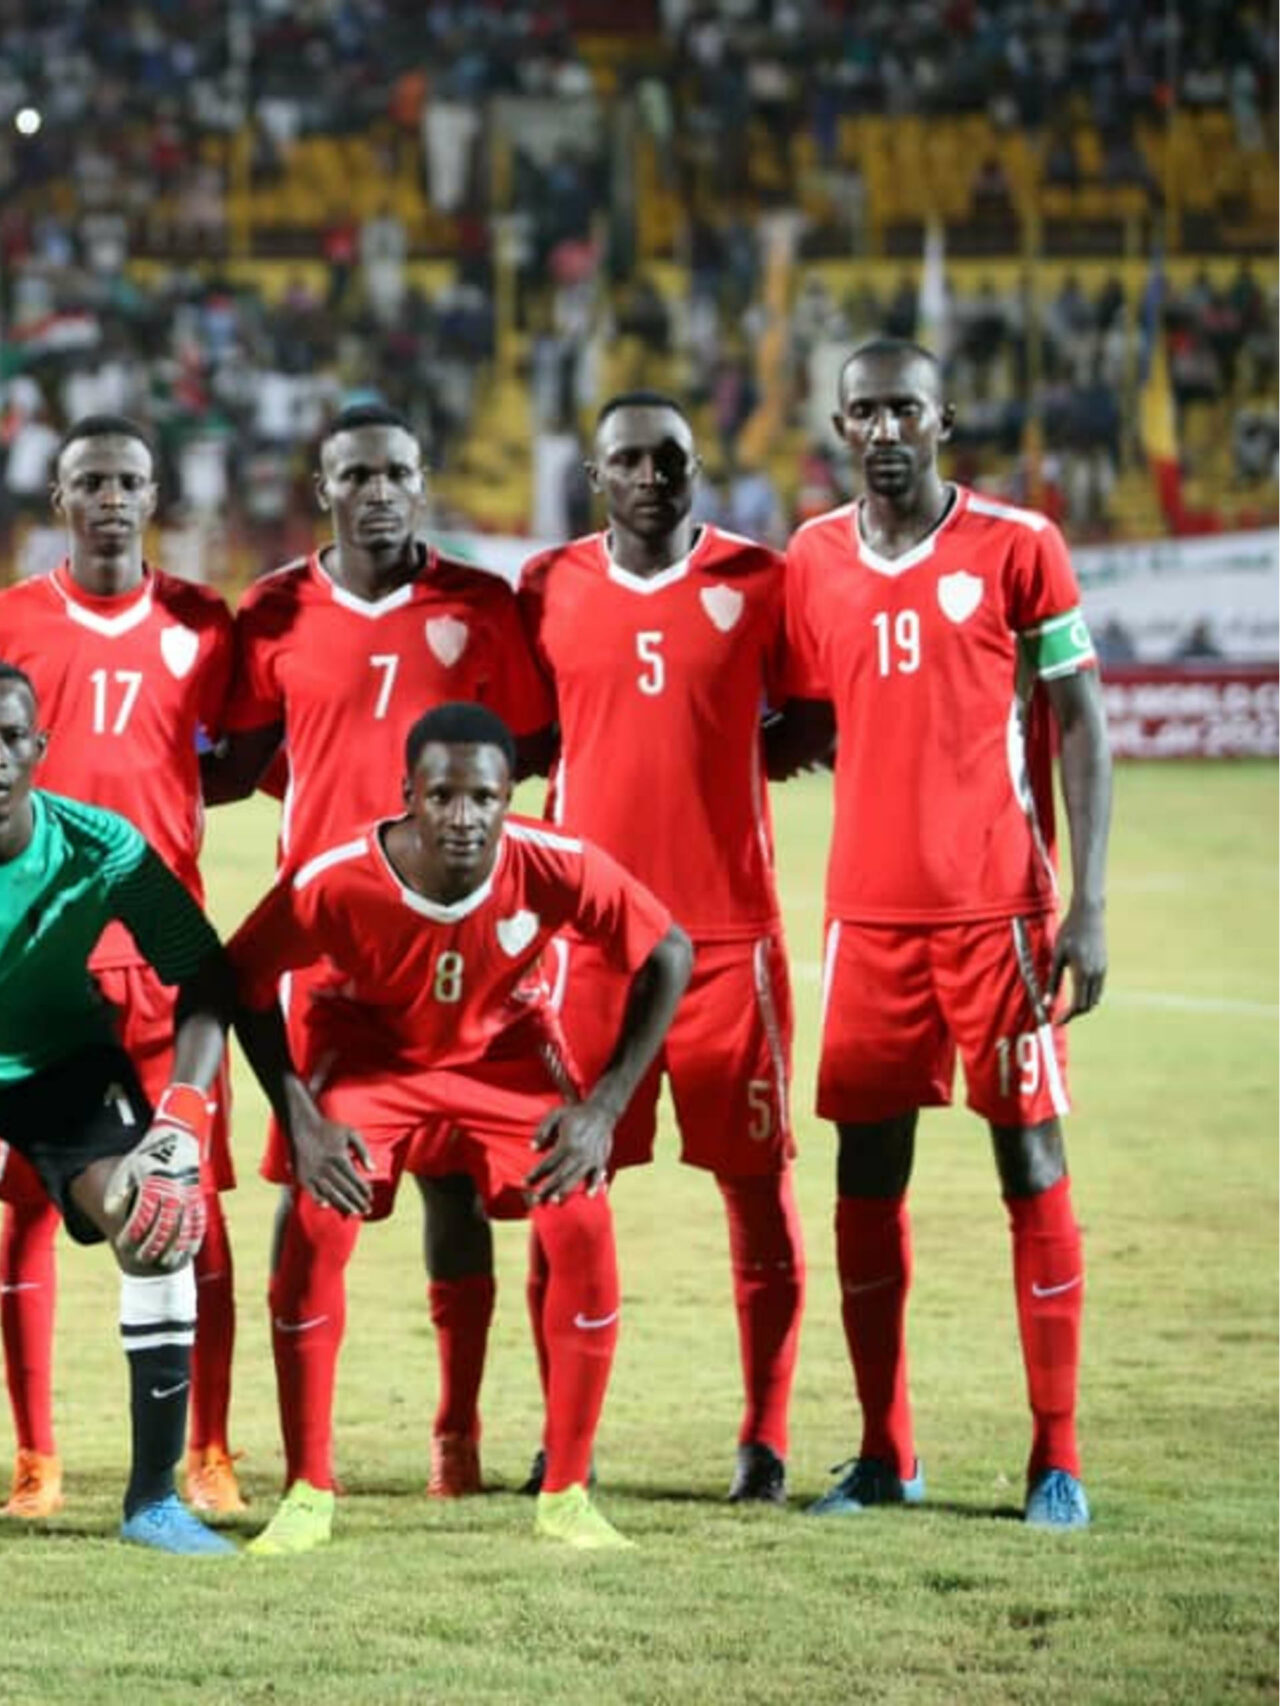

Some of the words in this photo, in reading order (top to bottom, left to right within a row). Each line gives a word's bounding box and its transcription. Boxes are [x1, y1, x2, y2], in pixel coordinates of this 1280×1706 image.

[636, 630, 665, 696] 5
[872, 609, 921, 676] 19
[90, 668, 143, 735] 17
[370, 653, 399, 719] 7
[434, 950, 465, 1003] 8
[995, 1033, 1039, 1098] 19
[747, 1079, 772, 1141] 5
